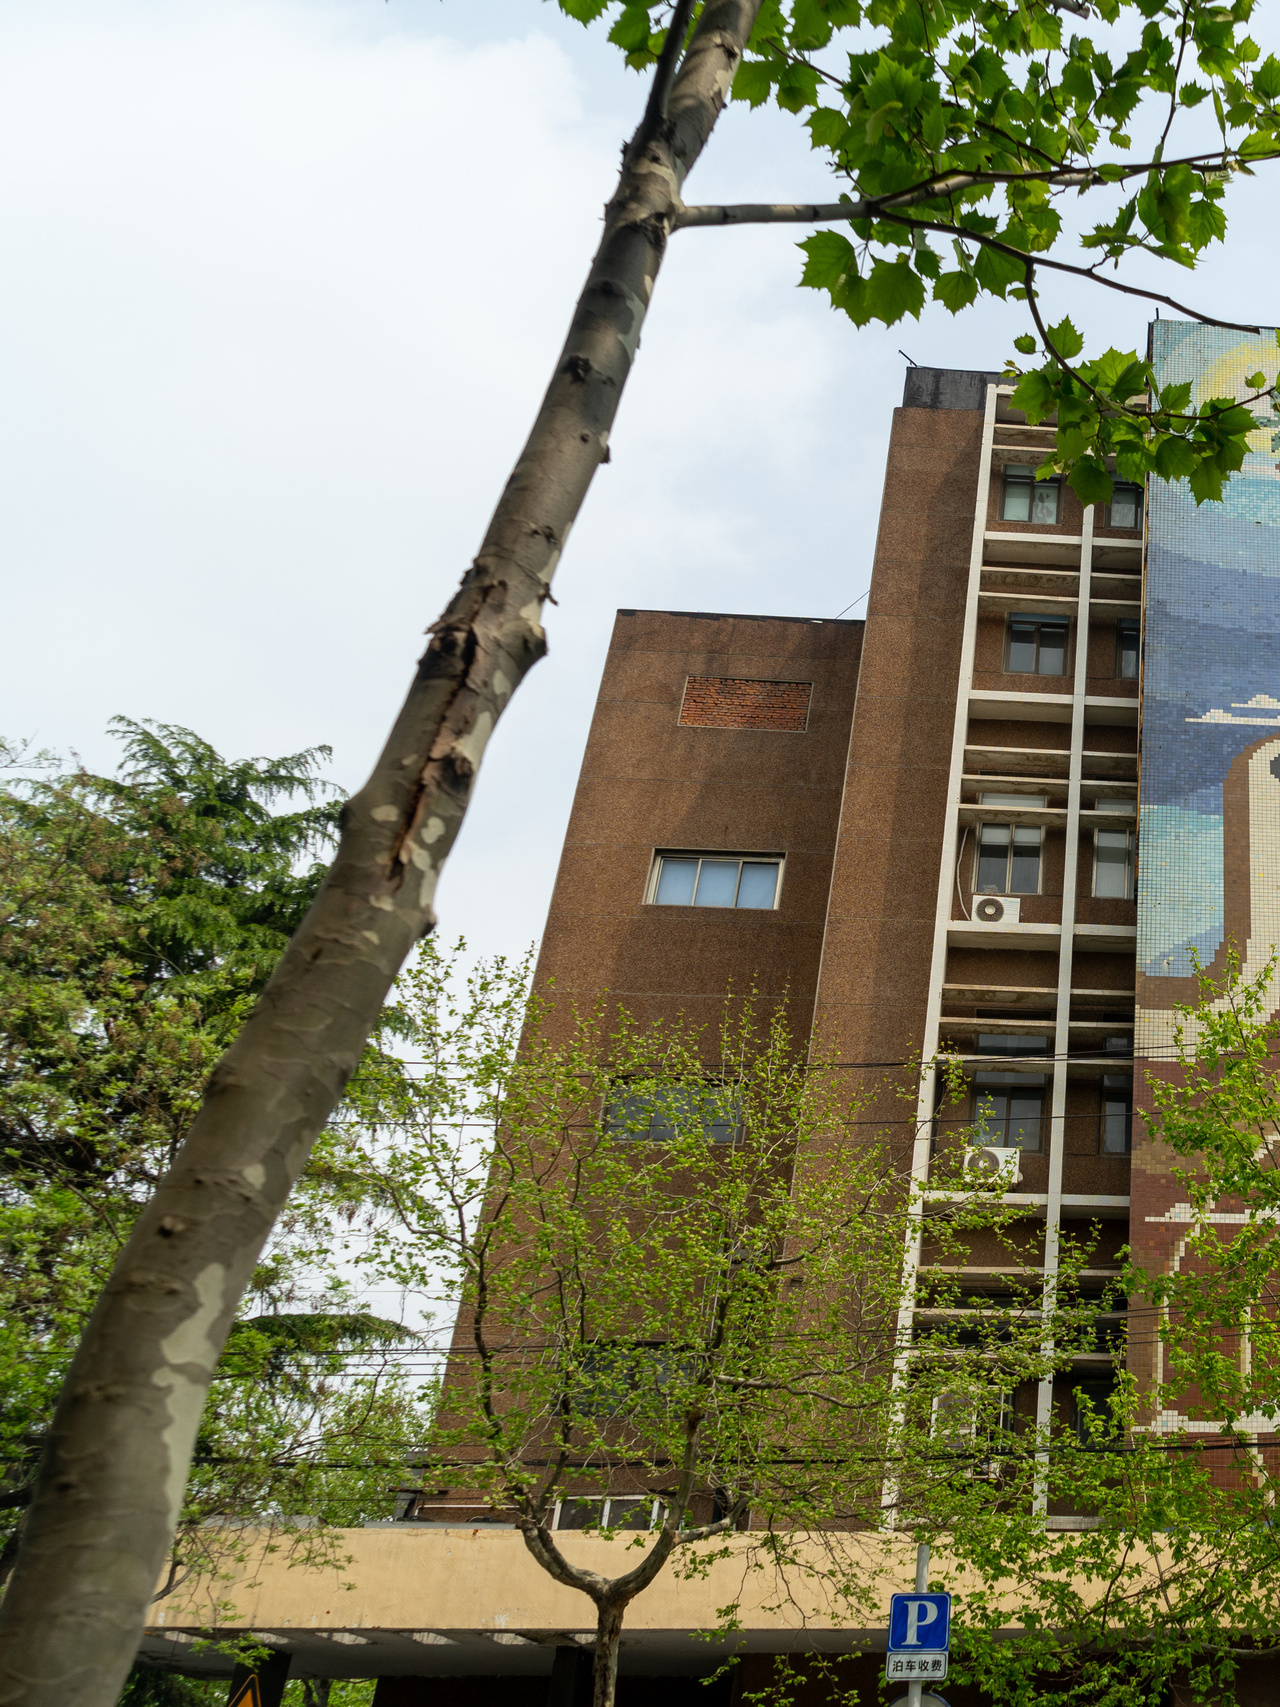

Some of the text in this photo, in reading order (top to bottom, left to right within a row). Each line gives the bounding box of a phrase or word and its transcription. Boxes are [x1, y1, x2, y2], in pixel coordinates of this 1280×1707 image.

[901, 1600, 939, 1646] P
[892, 1659, 942, 1673] 泊车收费
